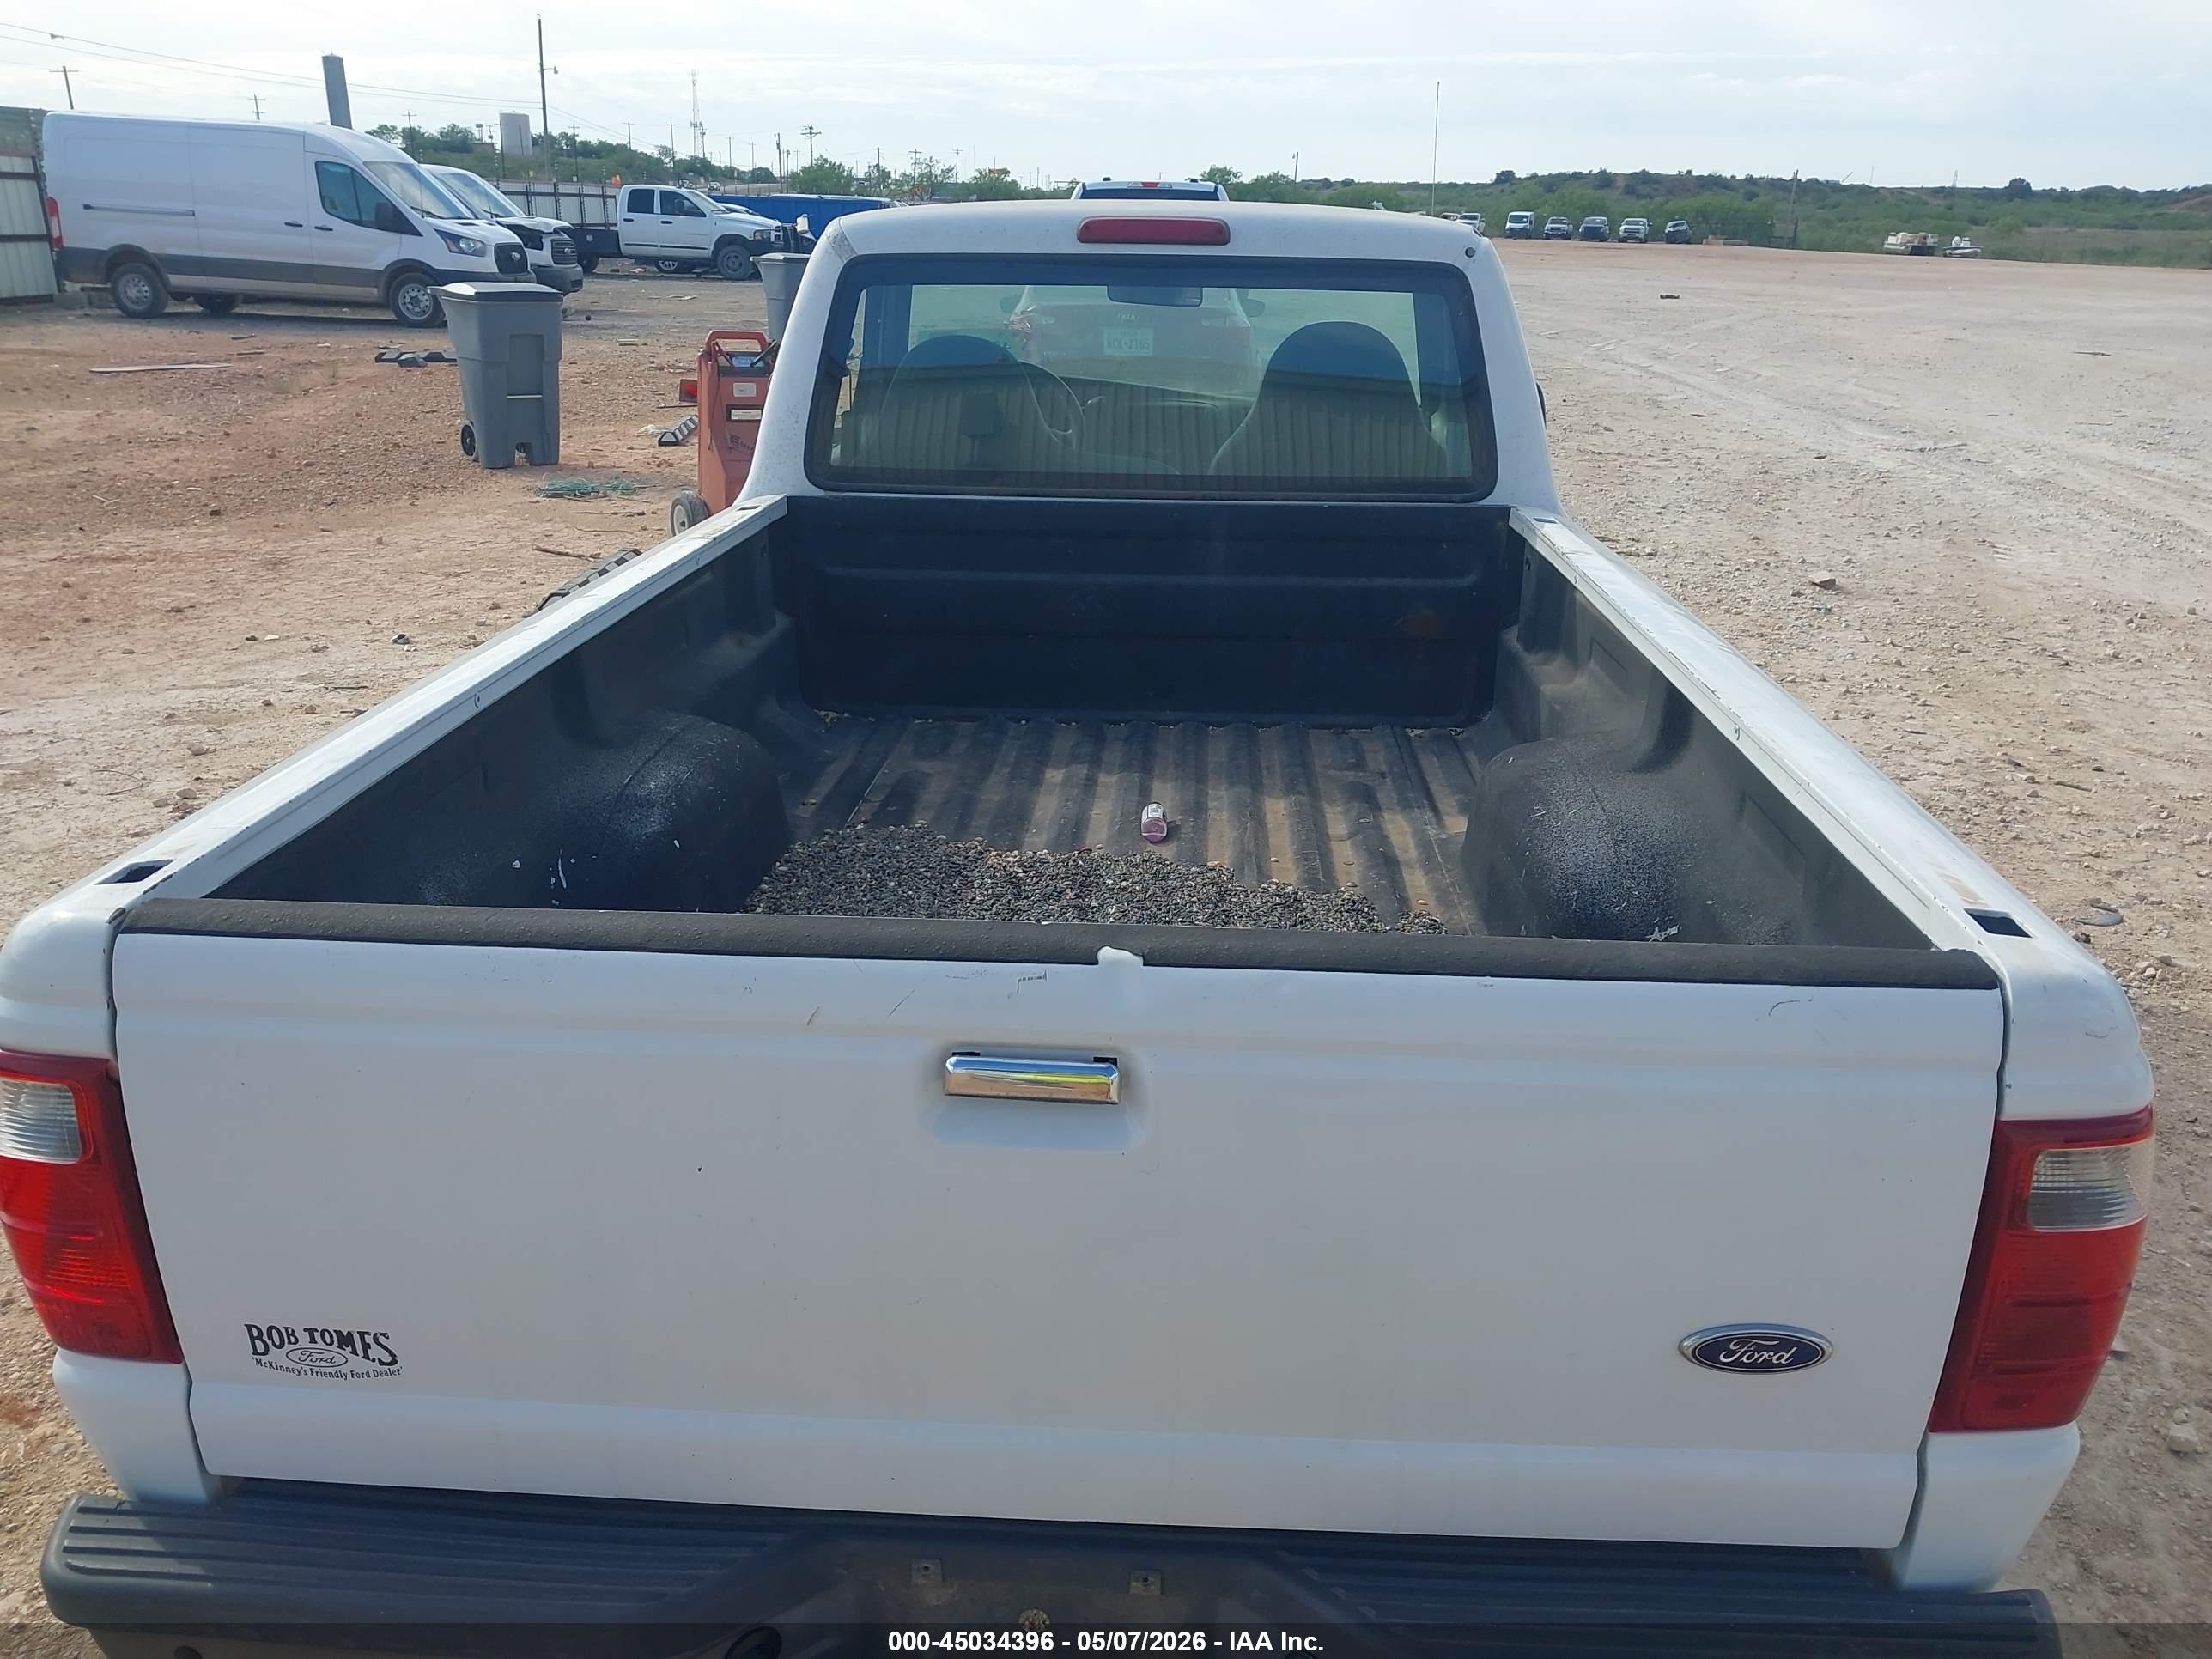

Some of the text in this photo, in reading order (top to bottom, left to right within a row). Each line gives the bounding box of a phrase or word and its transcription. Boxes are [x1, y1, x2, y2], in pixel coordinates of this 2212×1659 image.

[244, 1323, 398, 1367] BOB TOMES
[1719, 1338, 1798, 1365] Ford
[298, 1350, 337, 1365] Ford
[310, 1367, 348, 1382] Friendly
[350, 1370, 371, 1379] Ford
